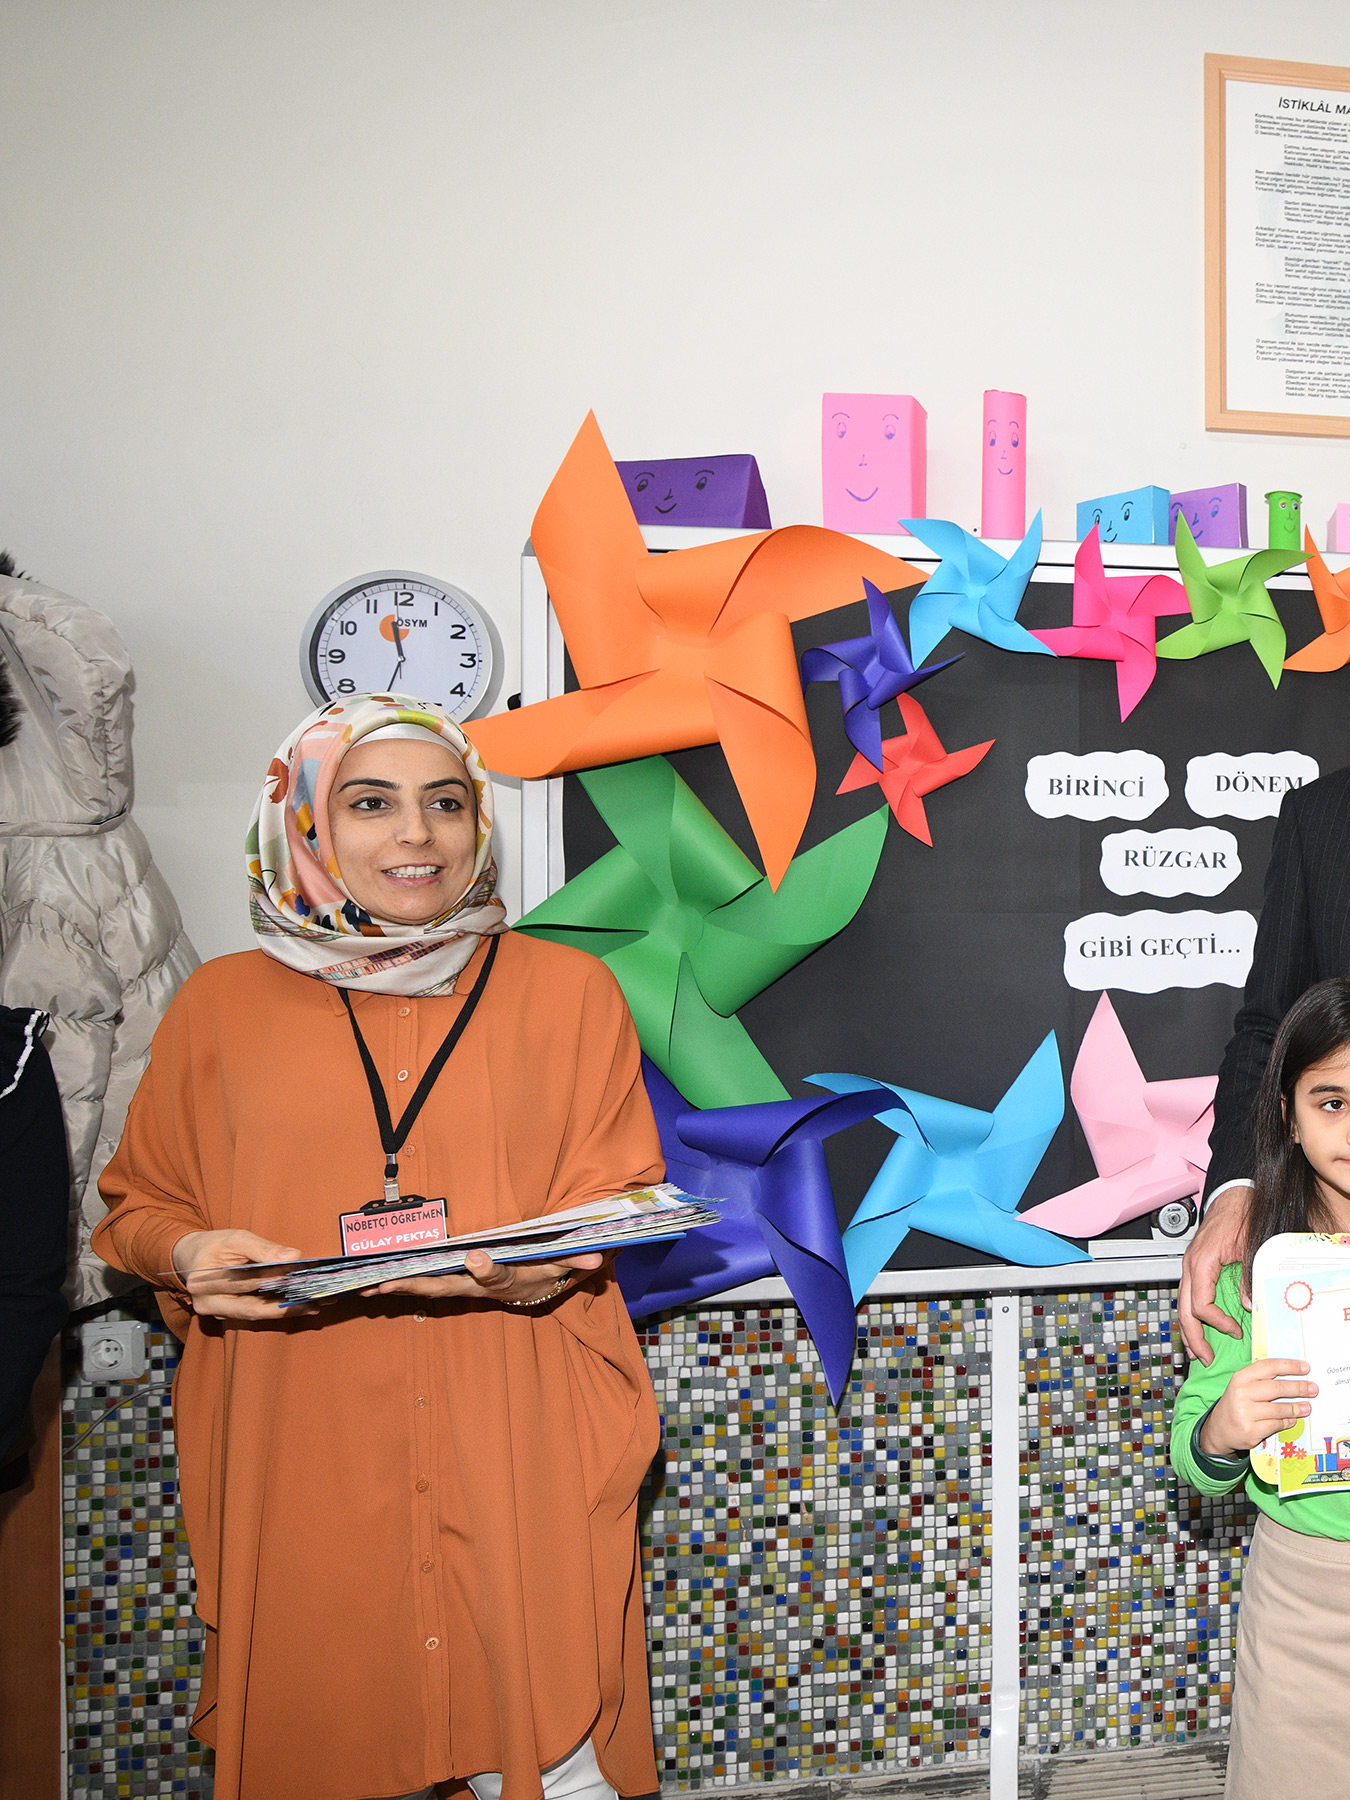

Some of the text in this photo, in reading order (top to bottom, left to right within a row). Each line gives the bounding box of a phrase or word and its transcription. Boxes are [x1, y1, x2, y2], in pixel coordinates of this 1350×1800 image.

[1278, 96, 1332, 114] İSTİKLÂL
[366, 599, 377, 614] 11
[394, 592, 414, 606] 12
[434, 602, 438, 616] 1
[340, 620, 357, 635] 10
[398, 616, 427, 627] ÖSYM
[450, 624, 466, 639] 2
[328, 649, 346, 664] 9
[459, 652, 477, 668] 3
[337, 678, 356, 693] 8
[450, 682, 466, 697] 4
[1048, 771, 1304, 798] BİRİNCİ DÖNEM
[1123, 845, 1228, 869] RÜZGAR
[1079, 933, 1241, 960] GİBİ GEÇTİ...
[346, 1208, 443, 1232] NÖBETÇİ ÖĞRETMEN
[350, 1228, 440, 1252] GÜLAY PEKTAŞ
